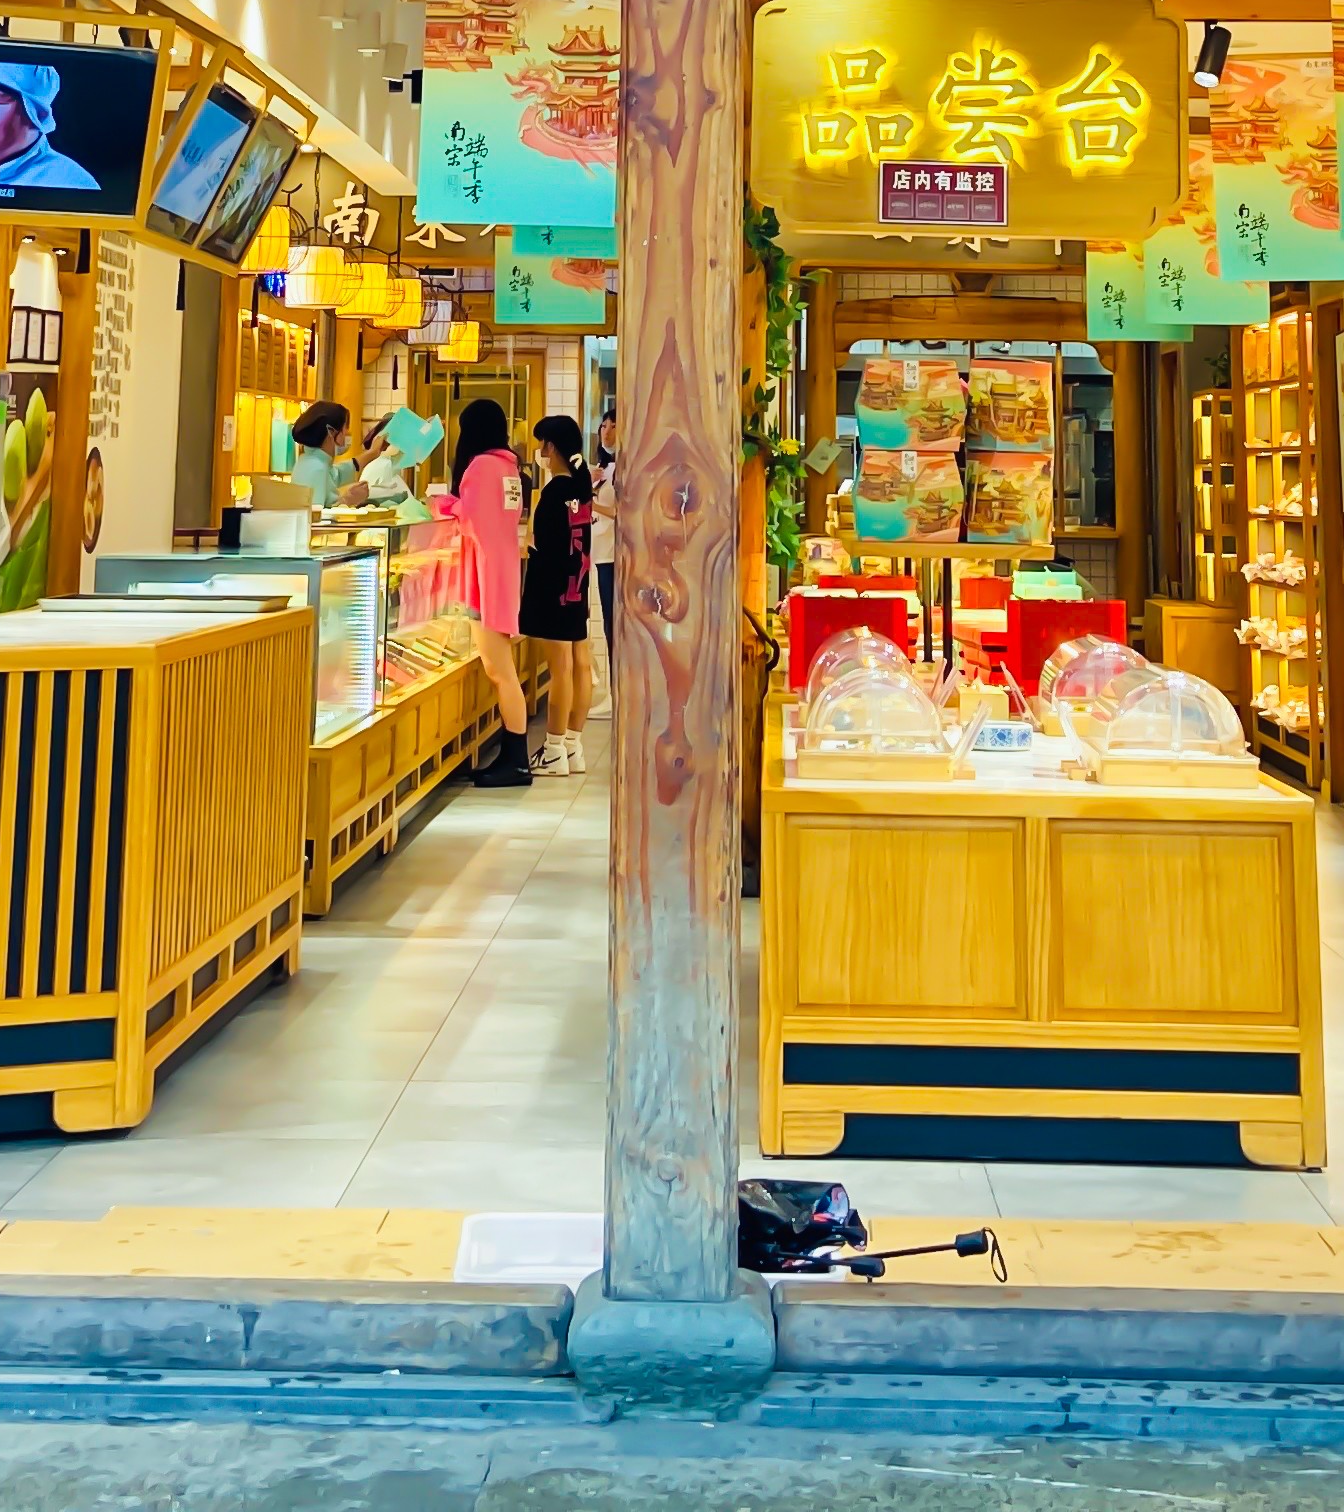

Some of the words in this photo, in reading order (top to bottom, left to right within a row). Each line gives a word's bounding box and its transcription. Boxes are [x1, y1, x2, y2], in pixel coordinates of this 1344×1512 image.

[803, 47, 1144, 162] 品尝台
[462, 132, 489, 204] 端午季
[892, 169, 996, 192] 店内有监控
